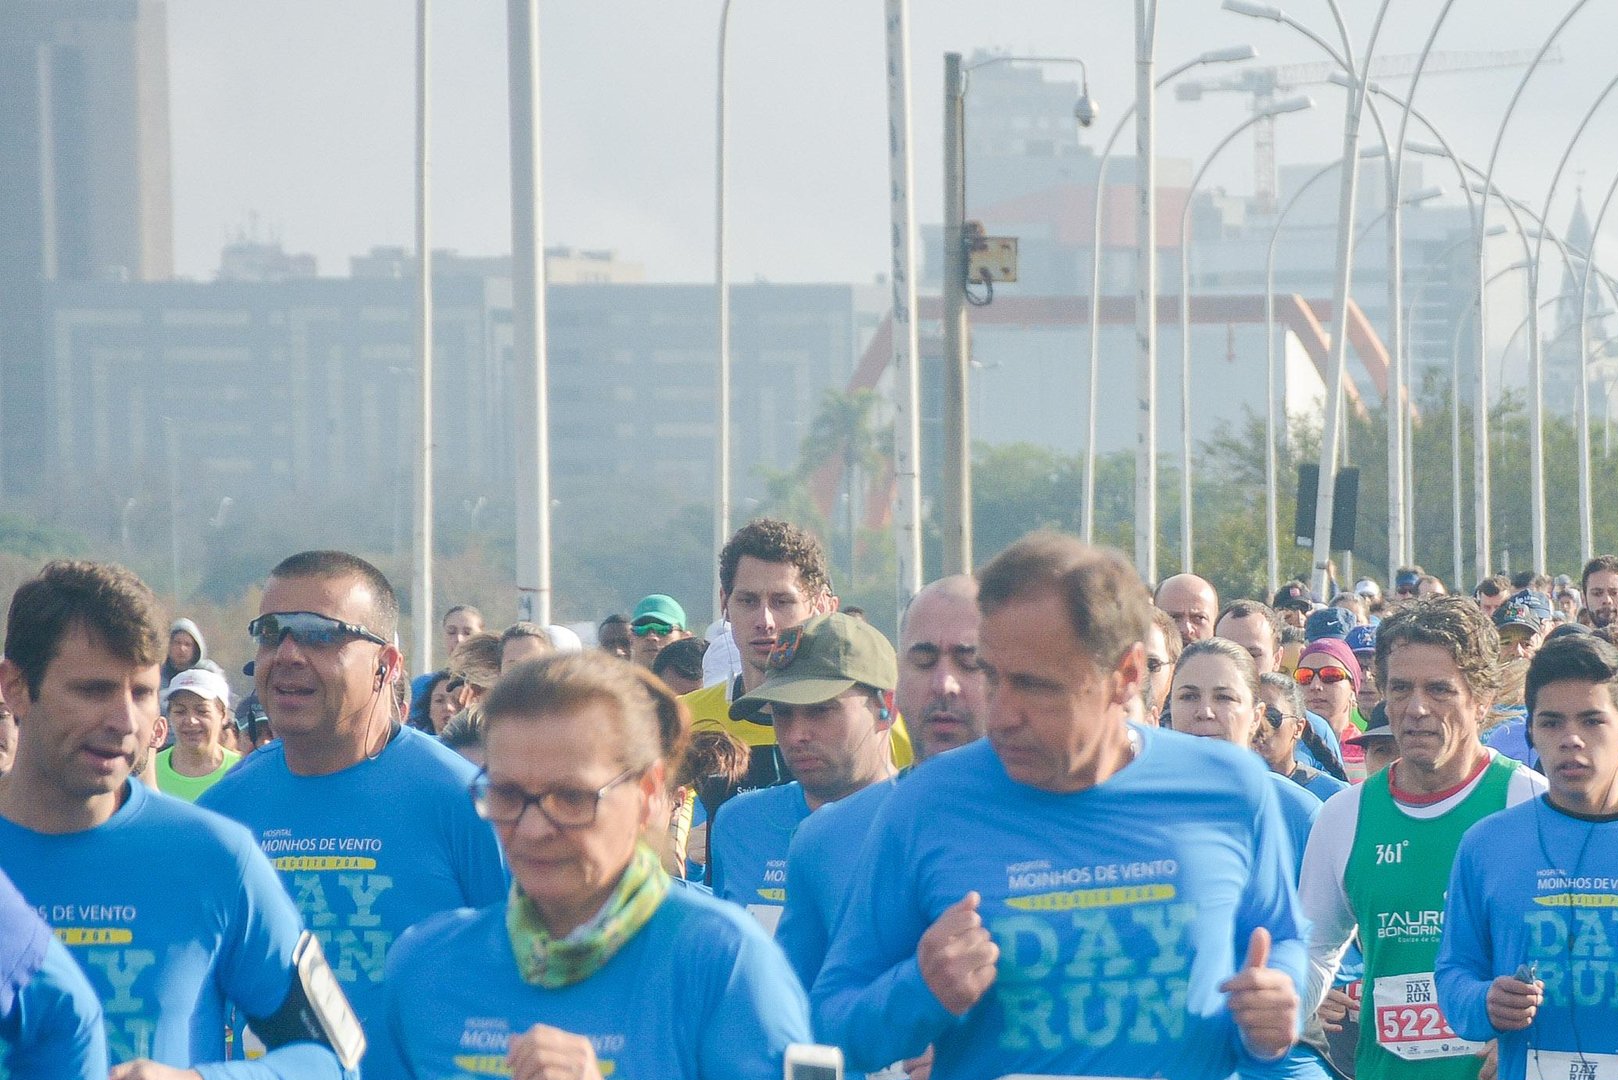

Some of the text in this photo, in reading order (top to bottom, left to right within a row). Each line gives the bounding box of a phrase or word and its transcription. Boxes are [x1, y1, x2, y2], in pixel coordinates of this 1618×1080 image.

[261, 838, 382, 852] MOINHOS DE VENTO
[275, 858, 327, 868] IRCUITO
[1008, 859, 1178, 891] MOINHOS DE VENTO
[1537, 877, 1592, 890] MOINHOS
[1593, 878, 1608, 889] DE
[294, 873, 394, 927] AY
[52, 904, 76, 921] DE
[79, 903, 137, 921] VENTO
[1378, 925, 1442, 938] BONORIN
[991, 903, 1198, 981] DAY
[1406, 983, 1430, 993] DAY
[1406, 992, 1431, 1003] RUN
[997, 978, 1190, 1050] RUN
[1570, 1063, 1598, 1074] DAY
